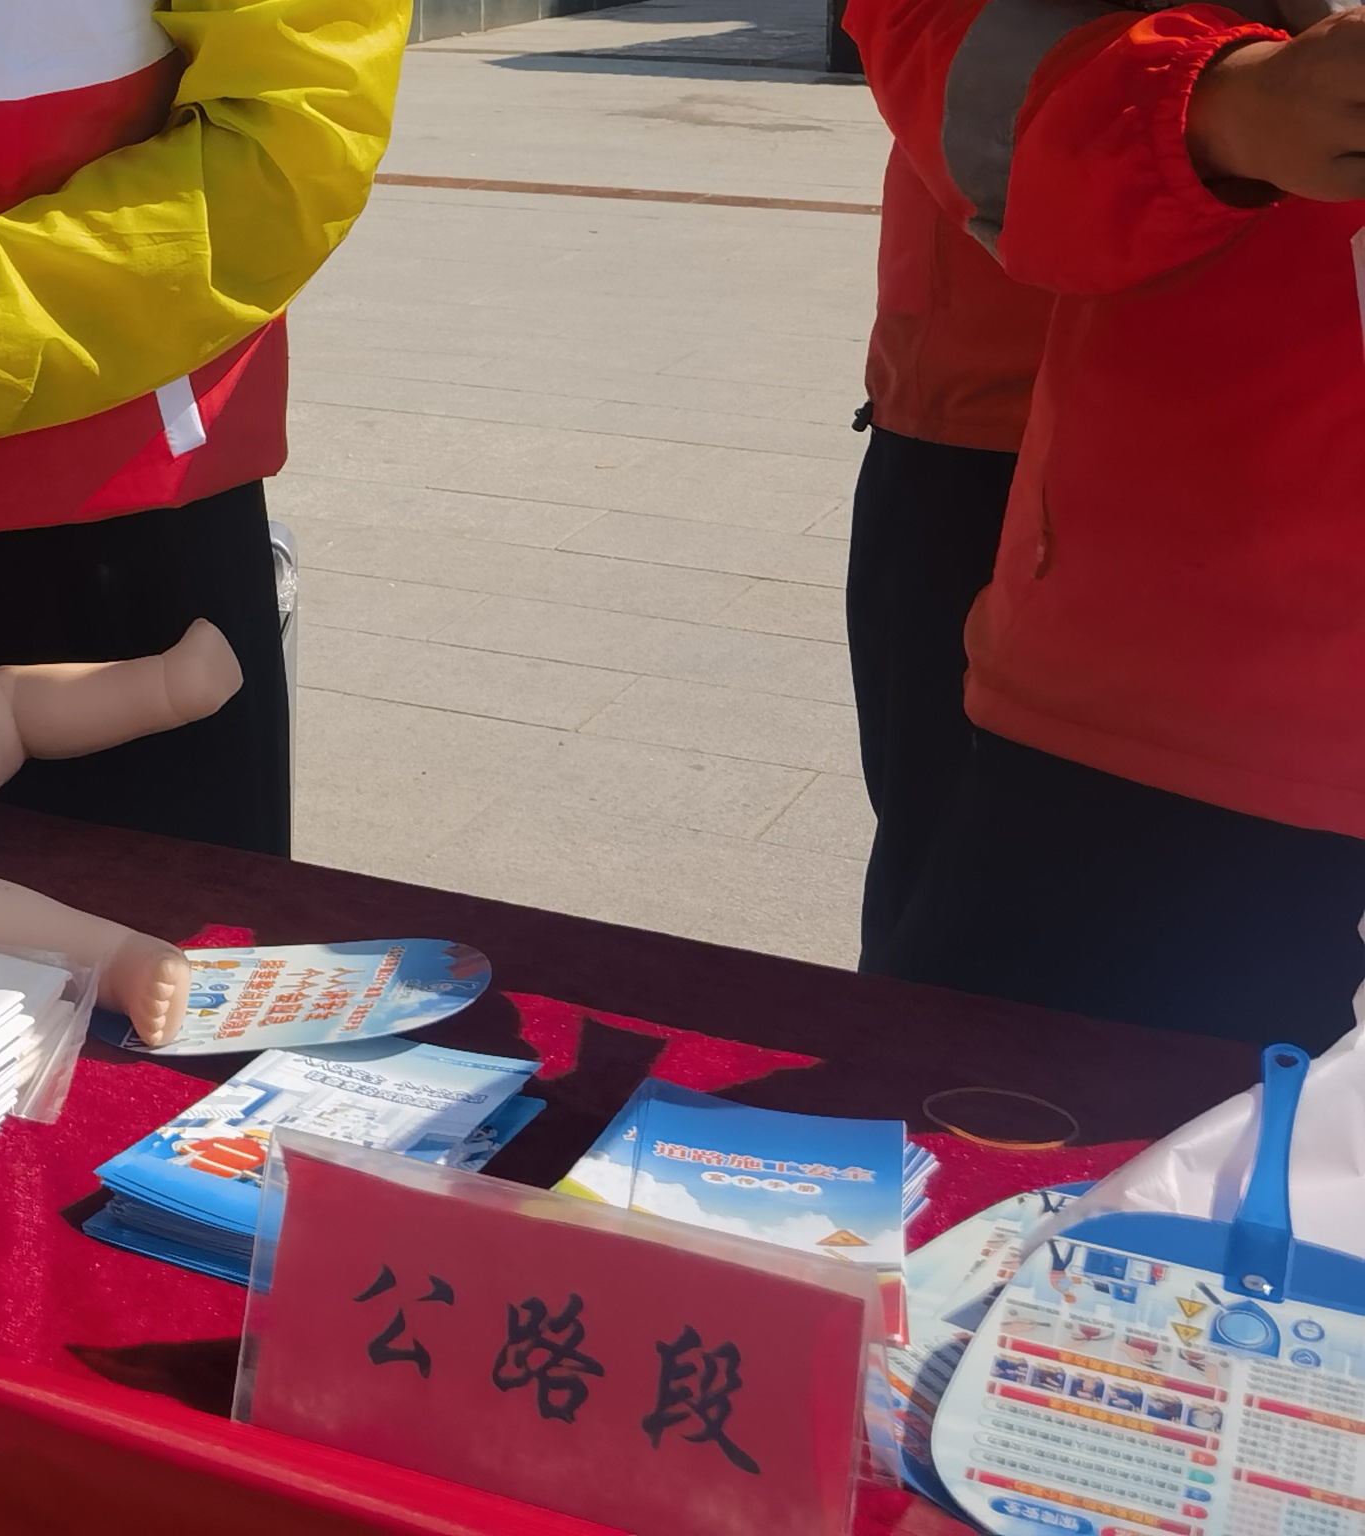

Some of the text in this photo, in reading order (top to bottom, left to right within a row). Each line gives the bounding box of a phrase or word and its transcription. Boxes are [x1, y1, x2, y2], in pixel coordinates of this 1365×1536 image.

[653, 1140, 877, 1183] 道路施工安全
[352, 1265, 762, 1477] 公路段
